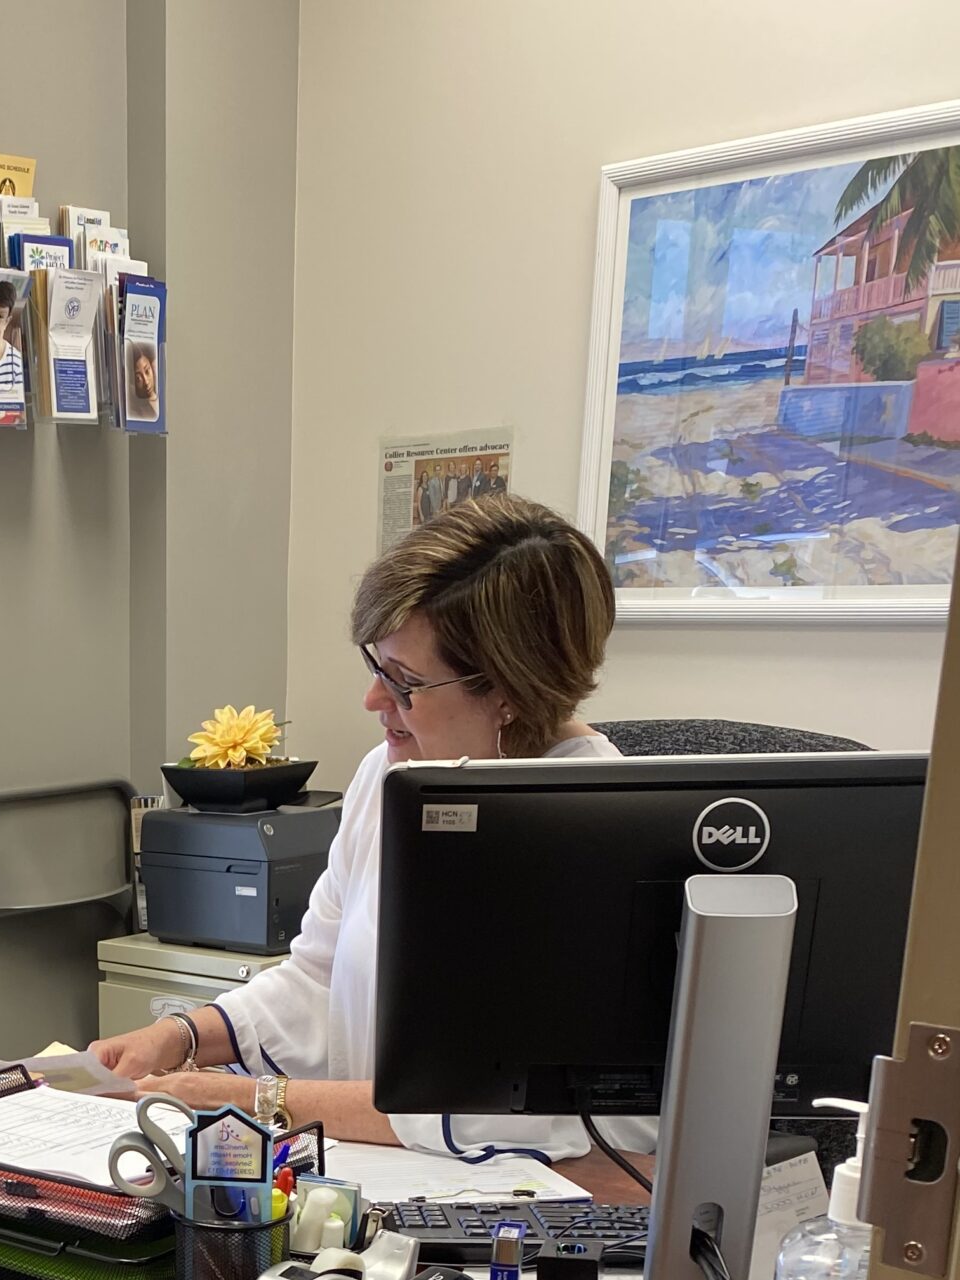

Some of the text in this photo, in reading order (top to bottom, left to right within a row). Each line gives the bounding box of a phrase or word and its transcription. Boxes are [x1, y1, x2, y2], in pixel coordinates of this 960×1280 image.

[131, 303, 156, 319] PLAN
[384, 451, 405, 459] Collier
[406, 449, 435, 457] Resource
[435, 446, 457, 455] Center
[458, 444, 478, 453] offers
[479, 442, 510, 452] advocacy
[702, 825, 760, 845] DELL
